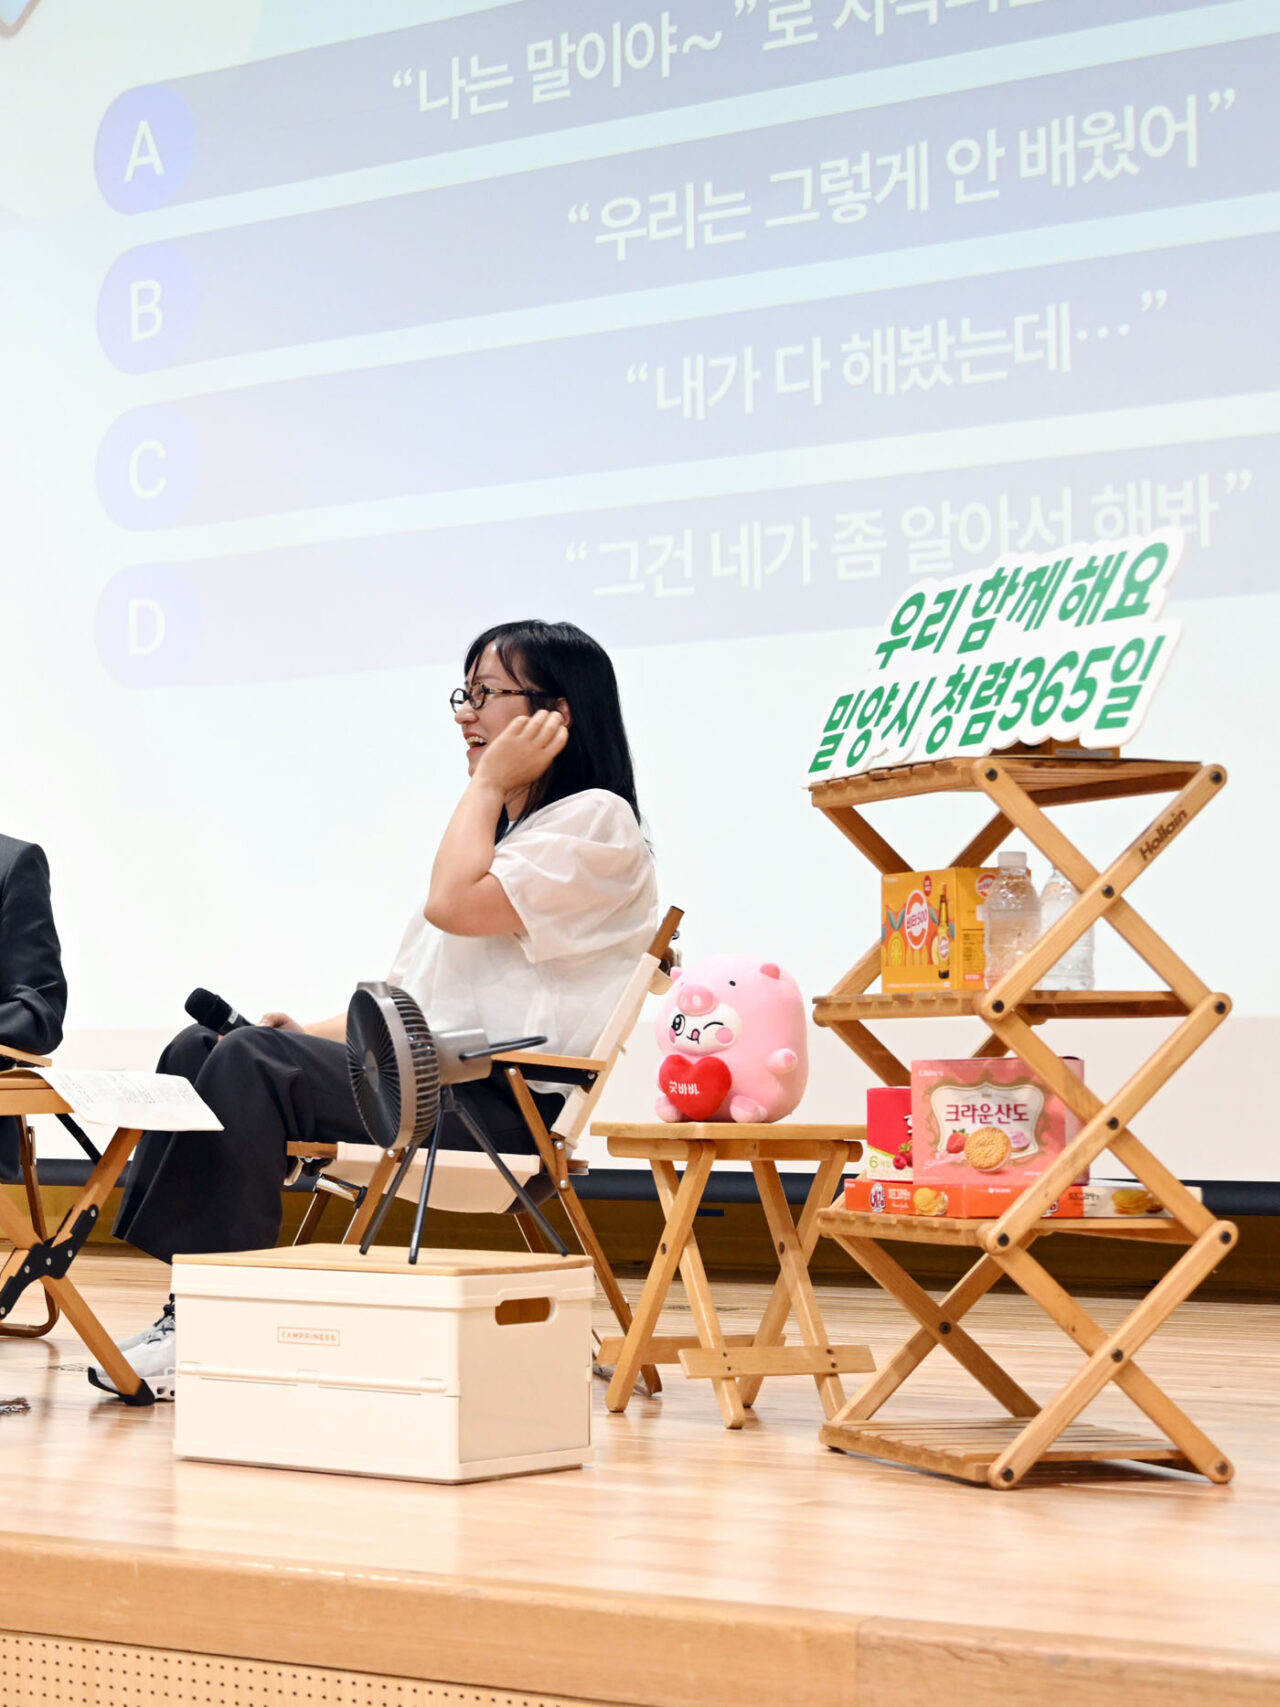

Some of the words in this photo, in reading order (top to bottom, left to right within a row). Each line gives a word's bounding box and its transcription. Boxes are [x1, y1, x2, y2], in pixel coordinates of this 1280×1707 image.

[123, 119, 165, 183] A
[764, 141, 931, 228] 그렇게
[945, 129, 1006, 205] 안
[129, 279, 164, 343] B
[774, 336, 831, 406] 다
[128, 439, 168, 499] C
[710, 514, 820, 592] 네가
[830, 509, 888, 581] 좀
[900, 487, 1072, 575] 알아서
[128, 597, 167, 656] D
[875, 584, 973, 670] 우리
[957, 556, 1074, 655] 함께
[1058, 541, 1170, 628] 해요
[807, 676, 938, 774] 밀양시
[945, 1103, 1030, 1125] 크라운산도
